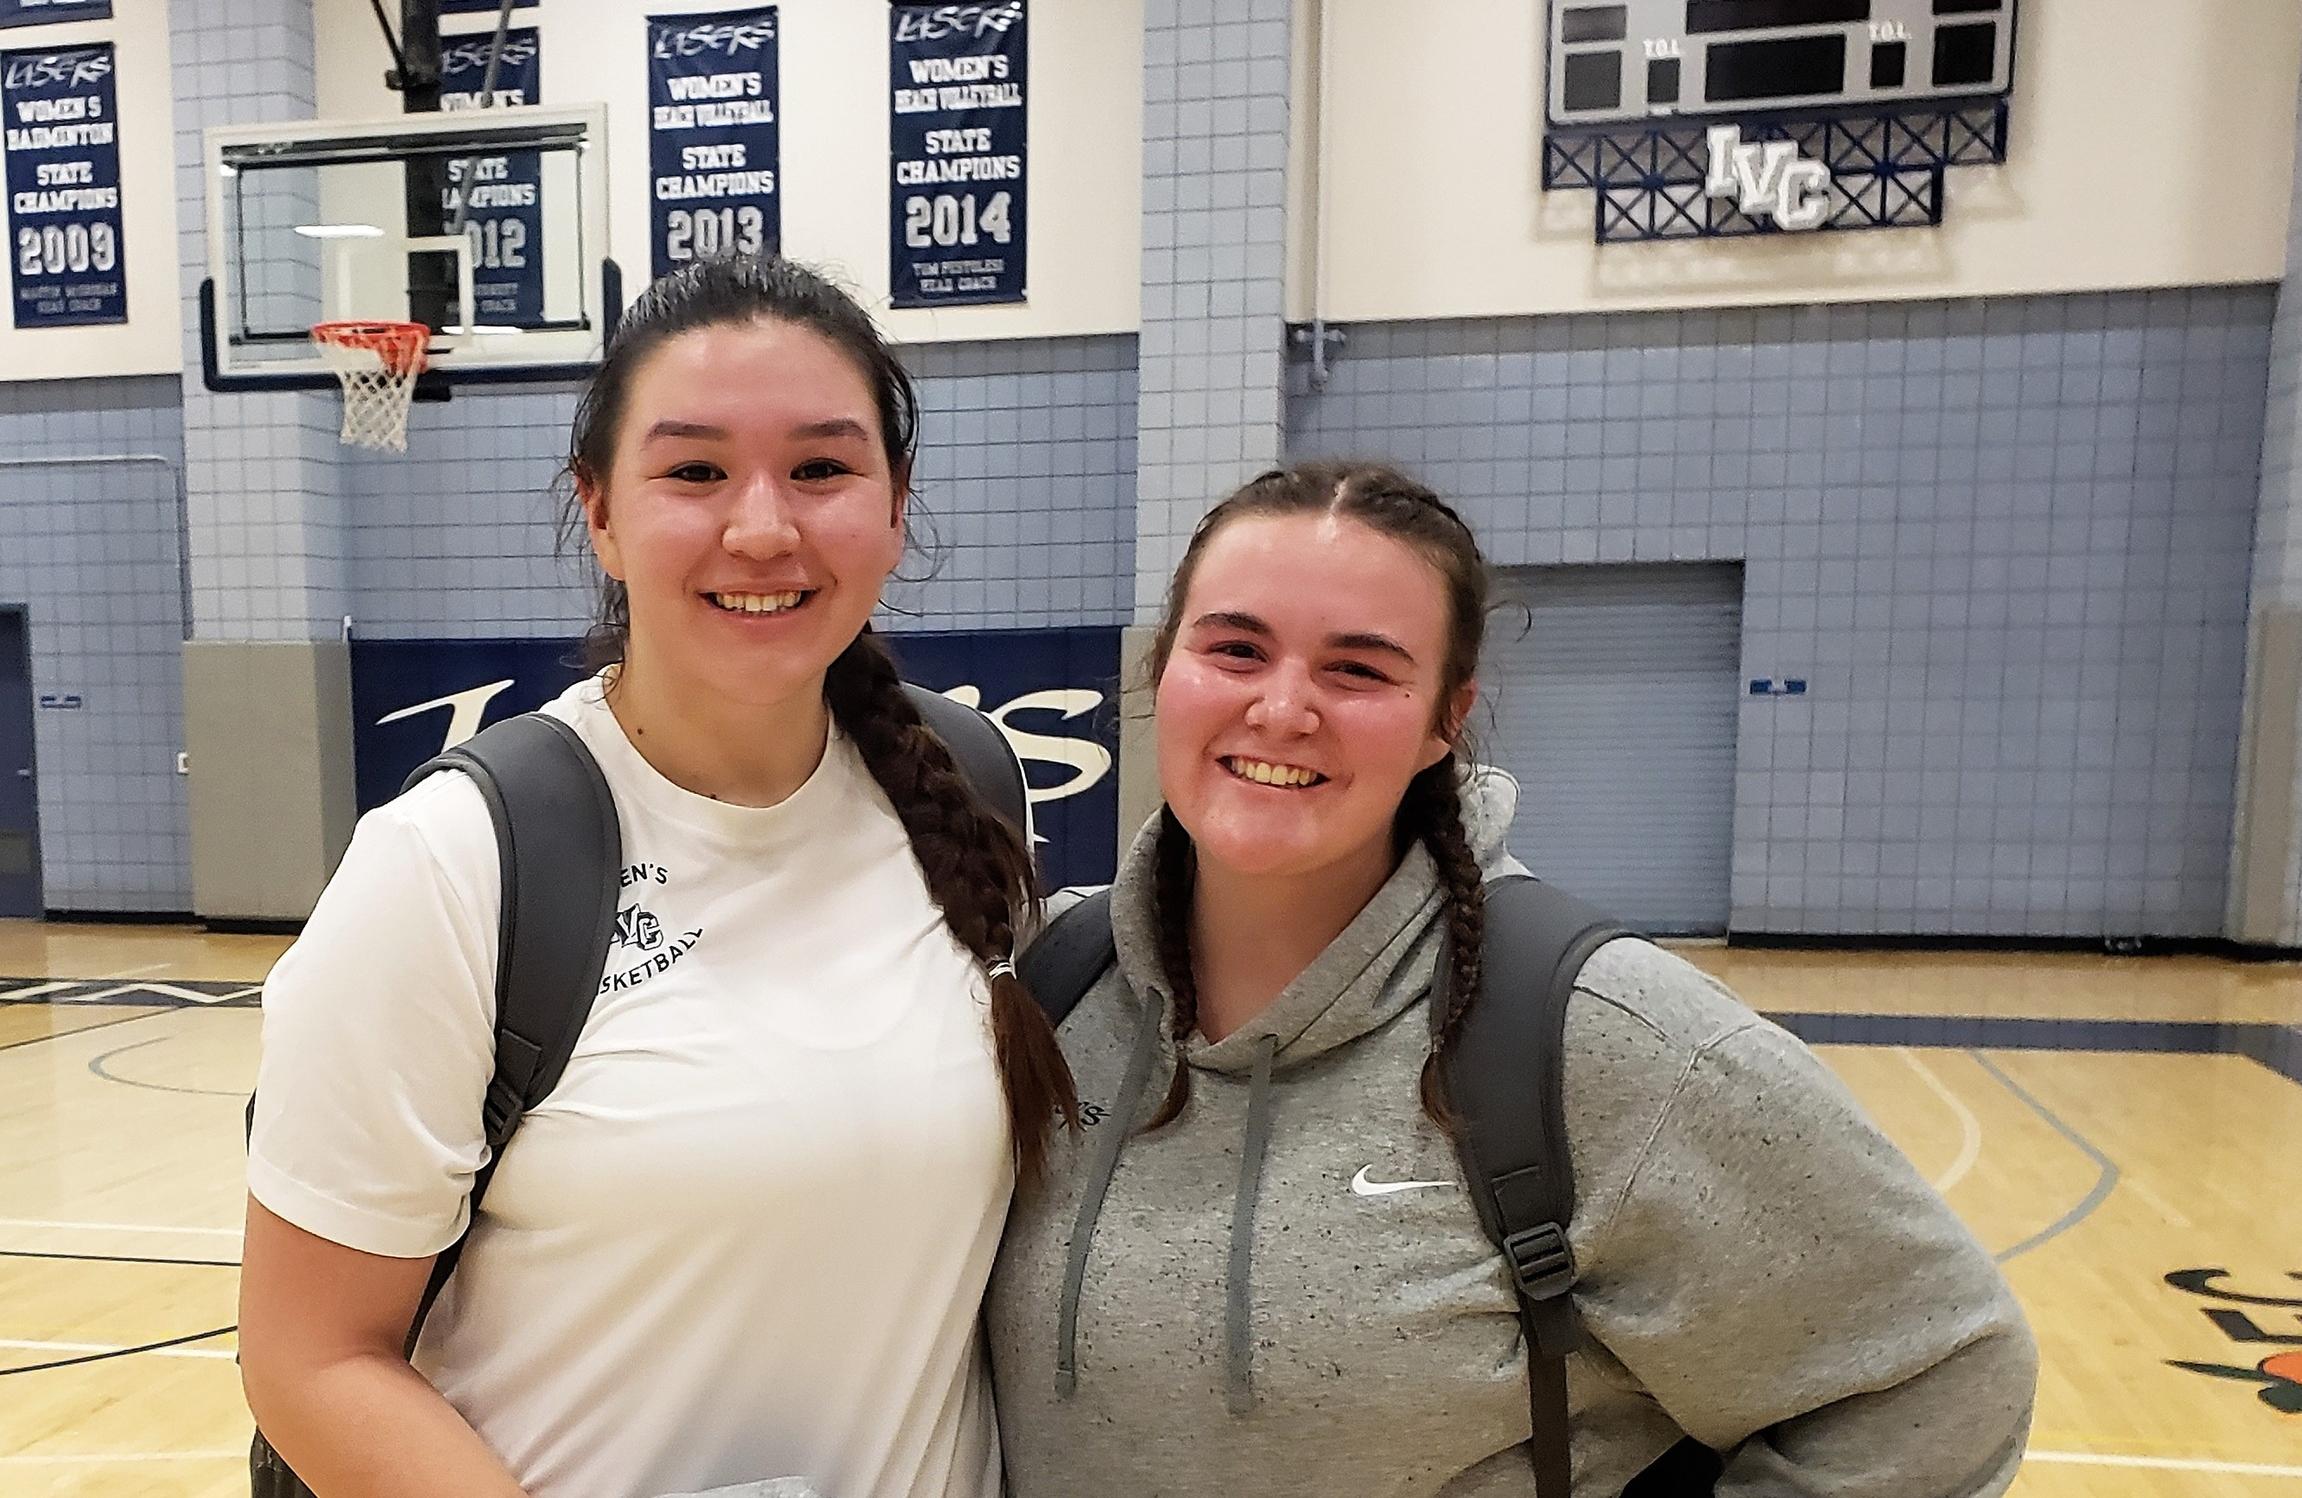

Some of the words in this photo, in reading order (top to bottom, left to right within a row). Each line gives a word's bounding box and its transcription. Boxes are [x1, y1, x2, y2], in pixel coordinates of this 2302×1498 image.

[908, 54, 1009, 84] WOMEN'S
[667, 71, 762, 101] WOMEN'S
[925, 127, 992, 155] STATE
[682, 143, 747, 170] STATE
[896, 154, 1022, 185] CHAMPIONS
[36, 161, 94, 187] STATE
[655, 170, 775, 200] CHAMPIONS
[1705, 123, 1831, 231] IVC
[13, 186, 119, 214] CHAMPIONS
[667, 205, 763, 260] 2013
[905, 191, 1012, 248] 2014
[18, 222, 115, 275] 2009
[446, 218, 527, 269] 012
[620, 862, 668, 888] EN'S
[611, 903, 664, 951] VC
[600, 928, 703, 994] SKETBALL
